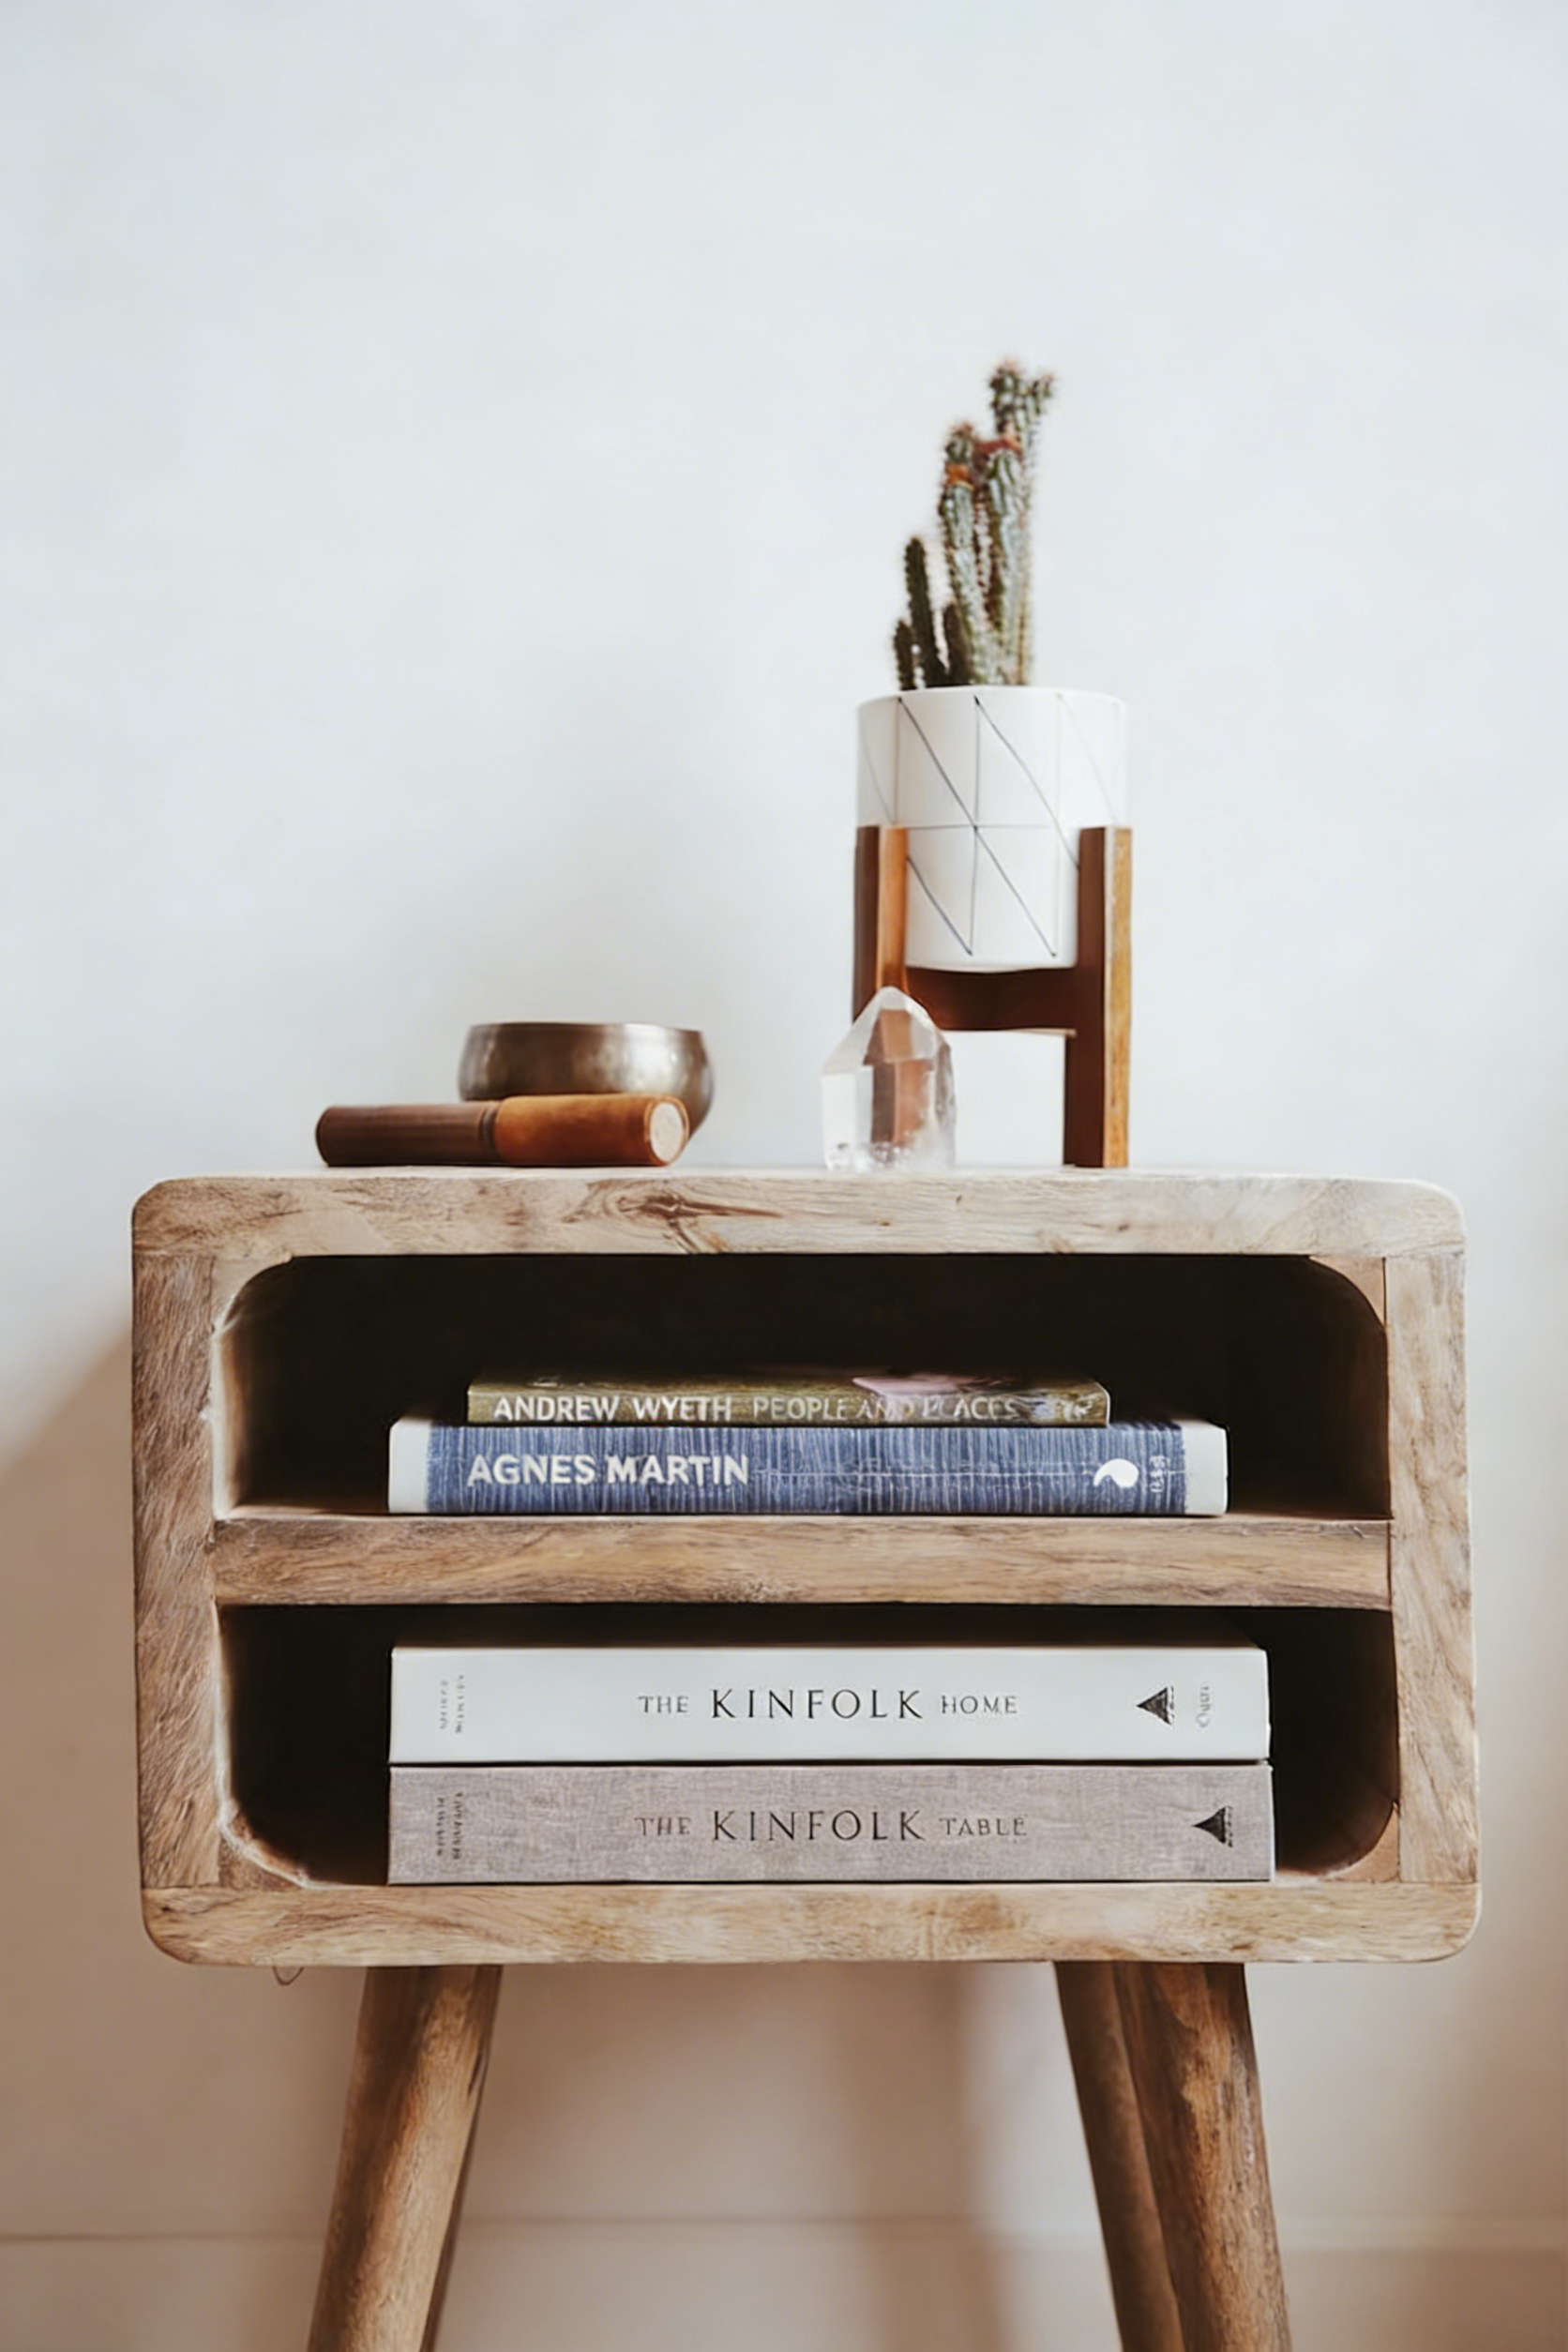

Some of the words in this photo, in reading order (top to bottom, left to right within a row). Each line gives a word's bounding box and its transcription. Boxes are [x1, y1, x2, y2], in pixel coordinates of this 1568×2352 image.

[493, 1395, 620, 1421] ANDREW
[632, 1395, 731, 1421] WYETH
[753, 1396, 847, 1420] PEOPLE
[467, 1455, 596, 1486] AGNES
[608, 1455, 749, 1486] MARTIN
[638, 1696, 689, 1714] THE
[712, 1689, 923, 1719] KINFOLK
[941, 1696, 1018, 1714] HOME
[635, 1817, 692, 1836] THE
[713, 1810, 925, 1841] KINFOLK
[938, 1817, 1029, 1836] TABLE
